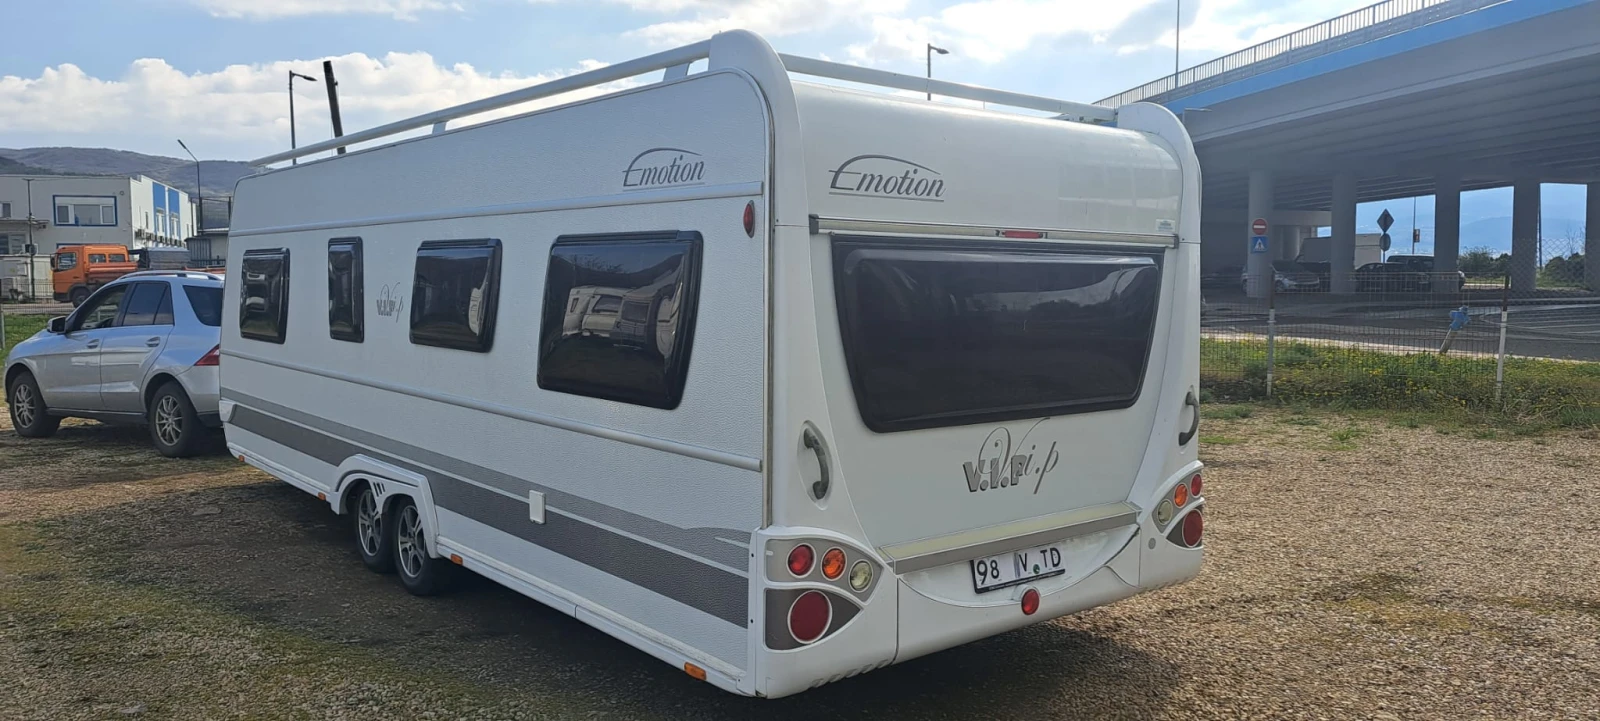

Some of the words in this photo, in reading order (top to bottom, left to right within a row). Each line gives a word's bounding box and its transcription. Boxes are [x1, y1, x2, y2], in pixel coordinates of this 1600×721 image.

[621, 147, 706, 187] Emotion
[828, 154, 946, 198] Emotion
[976, 559, 1000, 585] 98
[1039, 547, 1061, 568] TD
